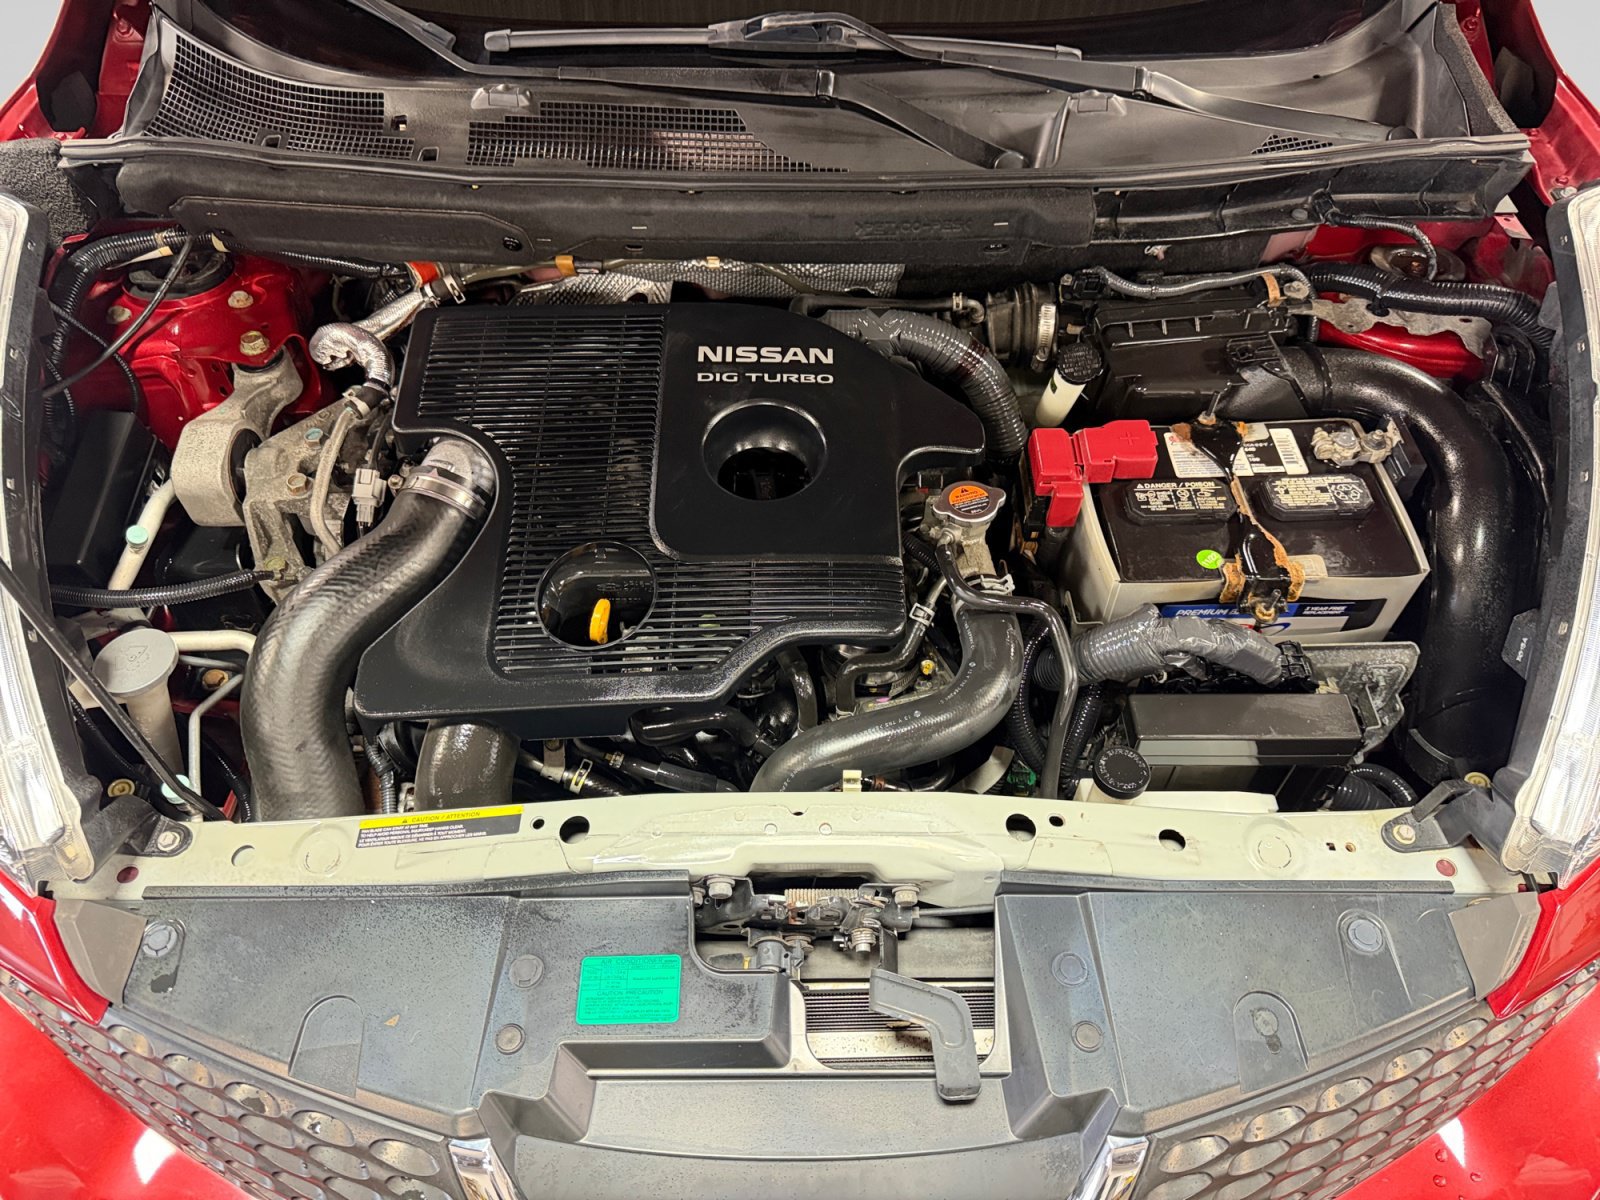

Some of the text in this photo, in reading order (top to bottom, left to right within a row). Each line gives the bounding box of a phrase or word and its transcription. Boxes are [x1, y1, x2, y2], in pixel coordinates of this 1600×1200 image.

[697, 346, 834, 365] NISSAN
[697, 372, 834, 384] DIG TURBO
[1176, 608, 1229, 616] PREMIUM
[412, 815, 439, 823] CAUTION
[446, 811, 480, 820] ATTENTION
[616, 957, 663, 965] CONDITIONER
